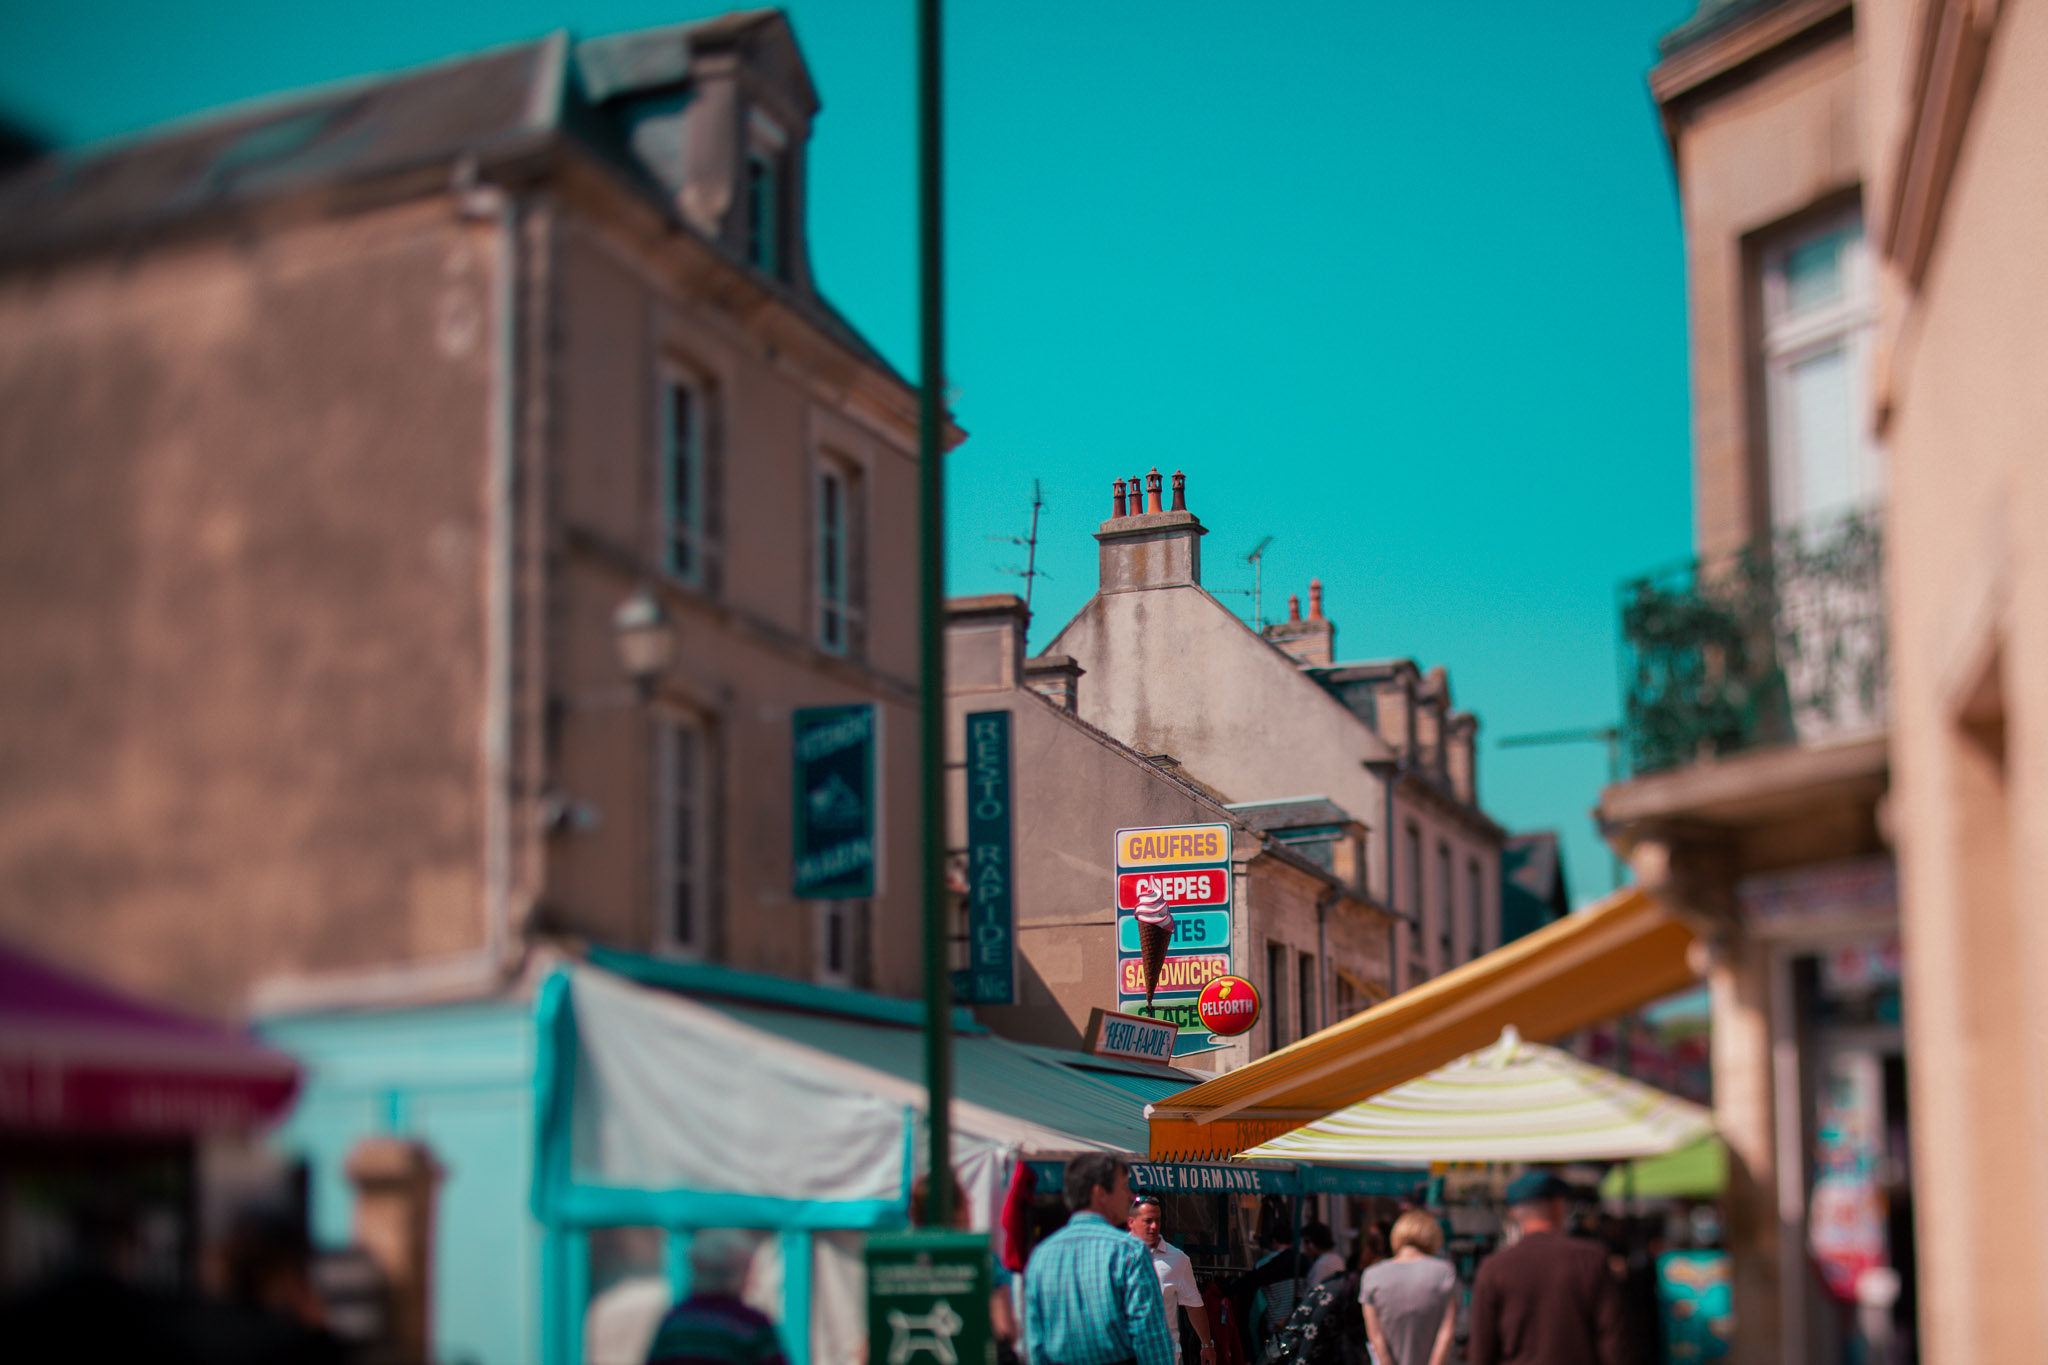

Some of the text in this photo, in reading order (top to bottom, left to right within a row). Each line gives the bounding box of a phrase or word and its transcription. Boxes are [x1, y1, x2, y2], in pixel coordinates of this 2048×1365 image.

[974, 721, 1005, 965] RESTO RAPIDE
[1129, 833, 1218, 860] GAUFRES
[1171, 918, 1206, 943] TES
[1125, 960, 1222, 988] SADWICHS
[1202, 998, 1254, 1017] PELFORTH
[1129, 1165, 1261, 1190] ETITE NORMANDE
